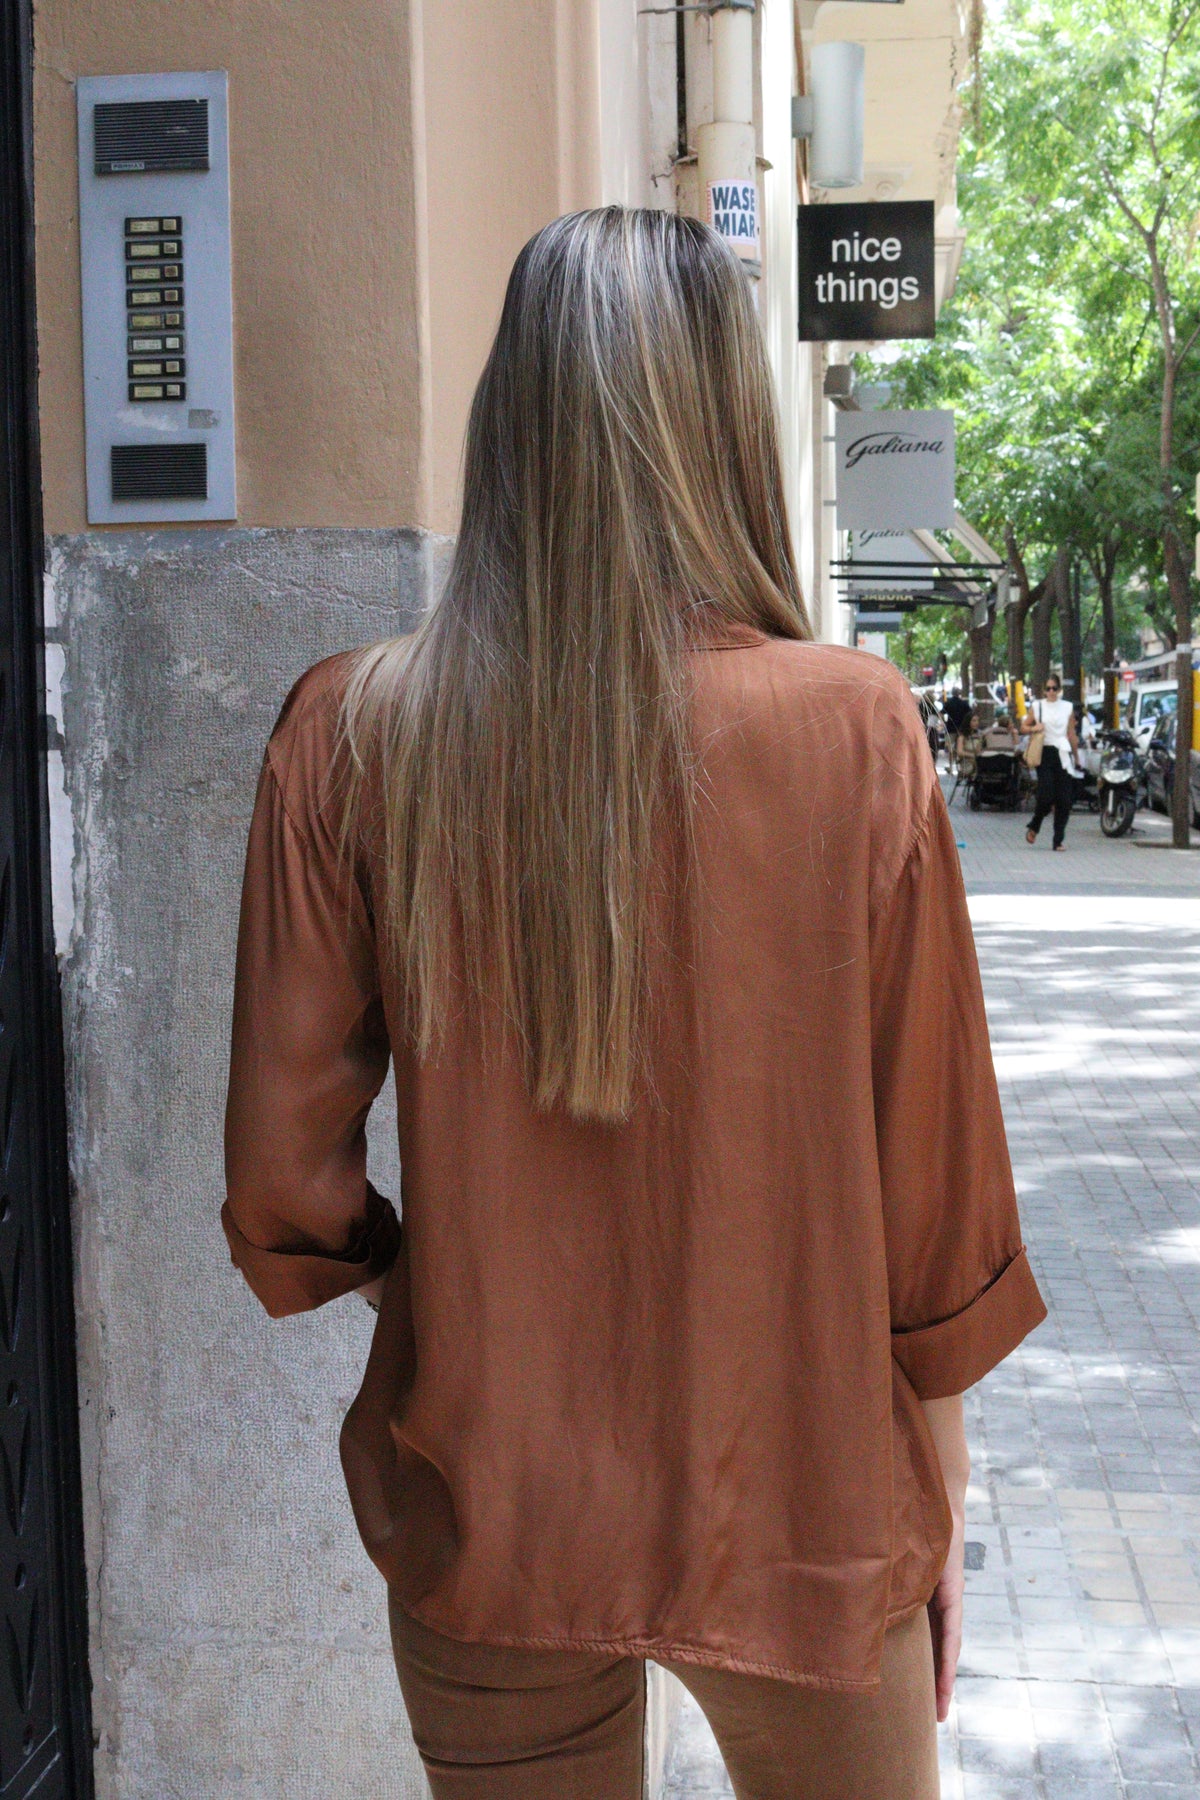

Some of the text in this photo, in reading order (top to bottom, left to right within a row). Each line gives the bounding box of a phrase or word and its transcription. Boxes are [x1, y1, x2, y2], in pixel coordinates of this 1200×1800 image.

[832, 231, 902, 262] nice
[815, 271, 919, 309] things
[845, 432, 944, 469] Galiana
